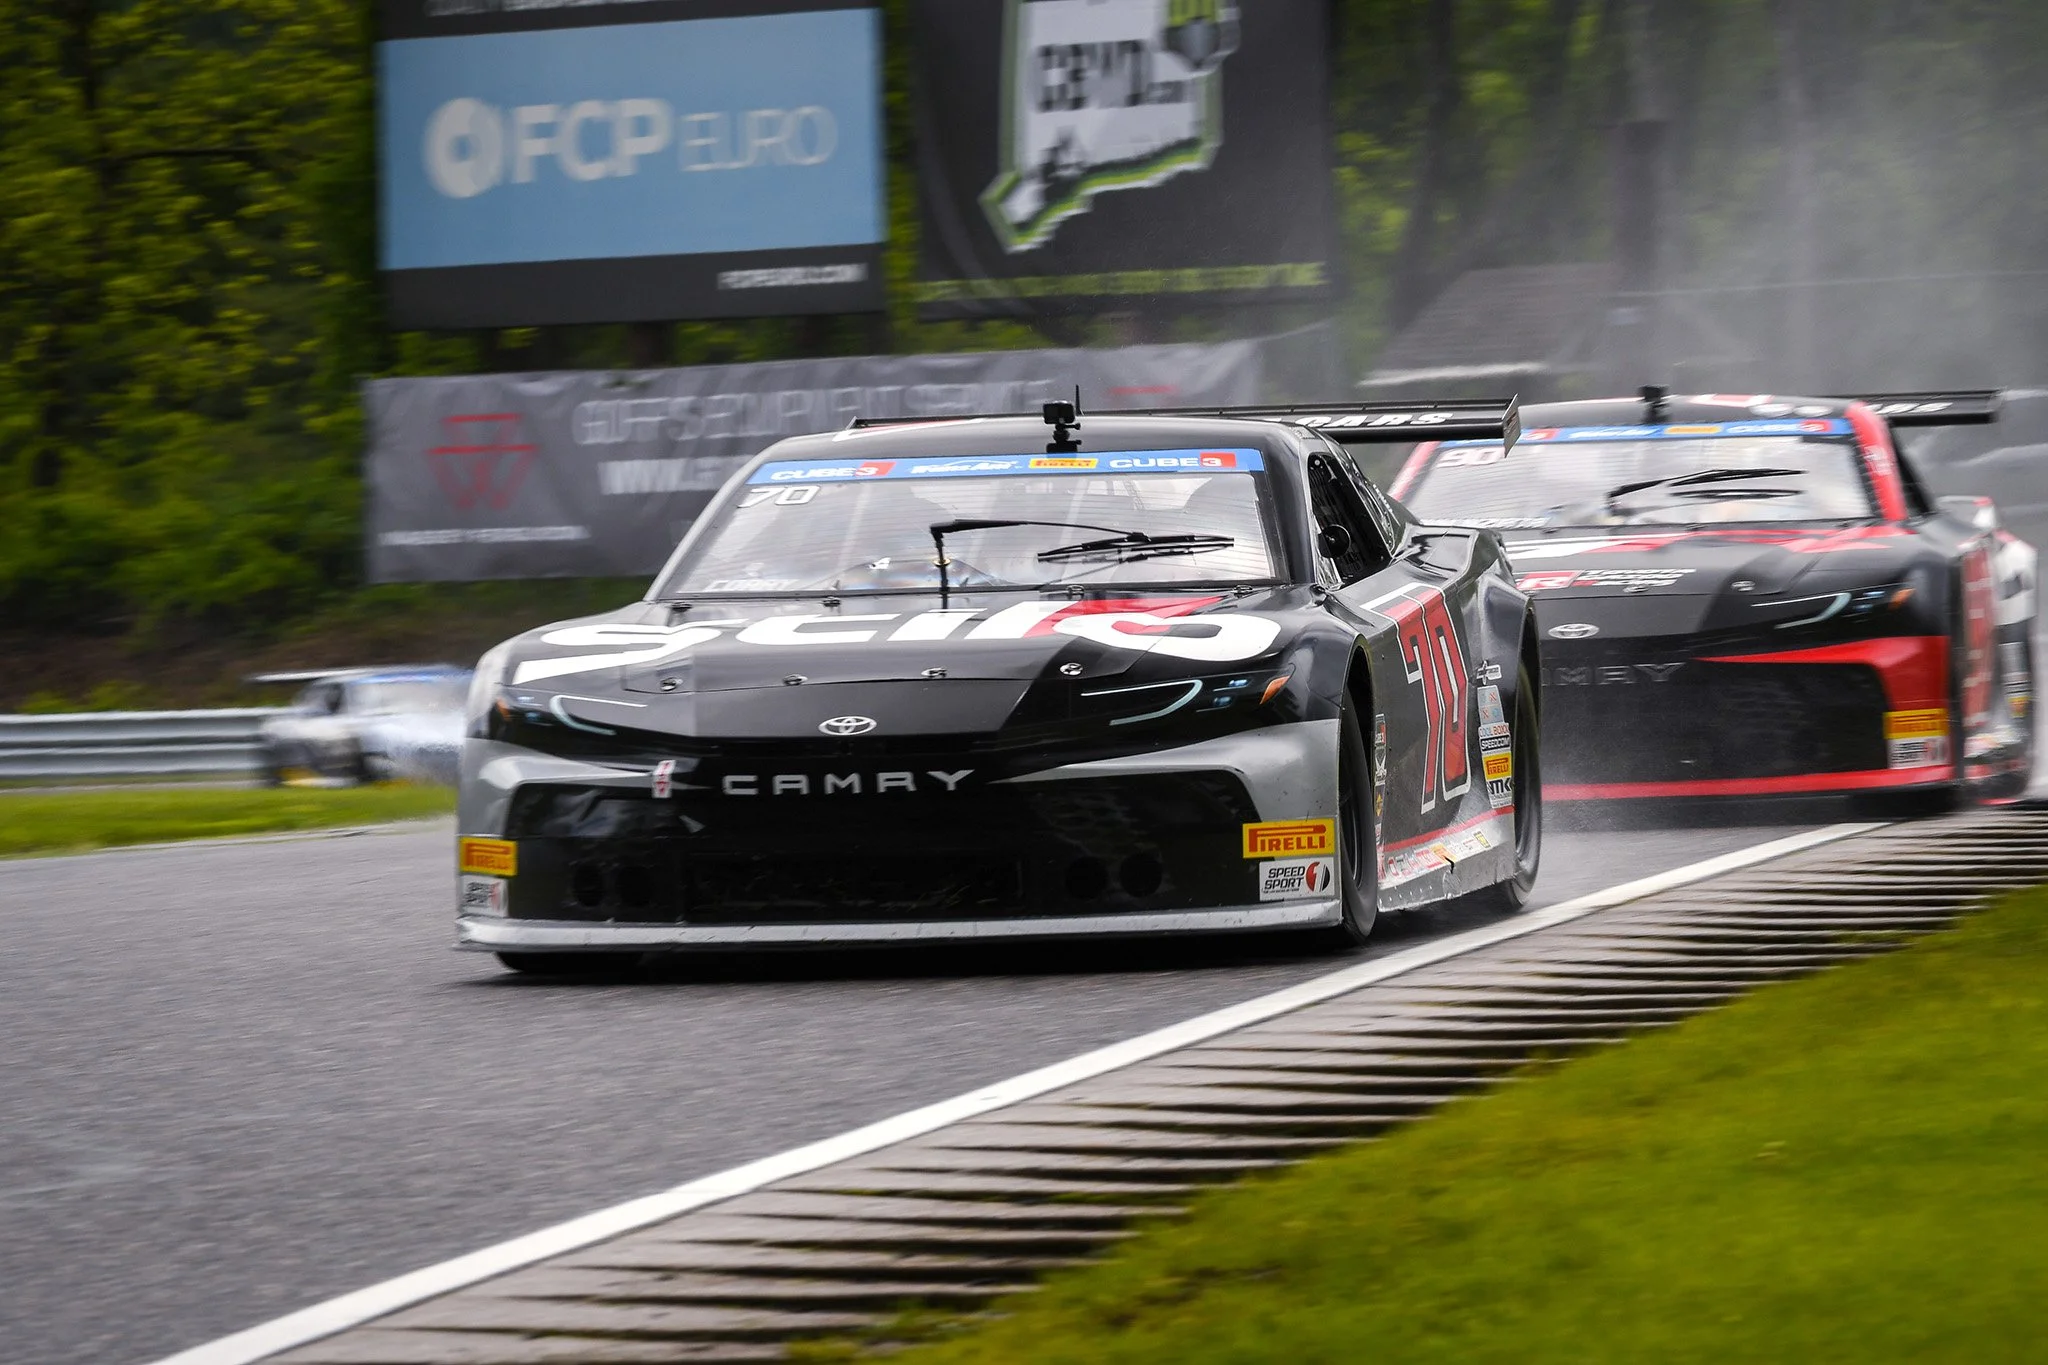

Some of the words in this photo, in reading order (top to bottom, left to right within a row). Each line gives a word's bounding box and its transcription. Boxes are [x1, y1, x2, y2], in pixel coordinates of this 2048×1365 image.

[510, 98, 672, 184] FCP
[679, 105, 839, 172] EURO
[771, 466, 878, 481] CUBE3
[1109, 457, 1222, 469] CUBE3
[737, 485, 820, 508] 70
[1359, 582, 1472, 815] 70
[722, 769, 976, 795] CAMRY
[1248, 824, 1327, 853] PIRELLI
[1264, 877, 1304, 890] SPORT
[1268, 866, 1306, 879] SPEED
